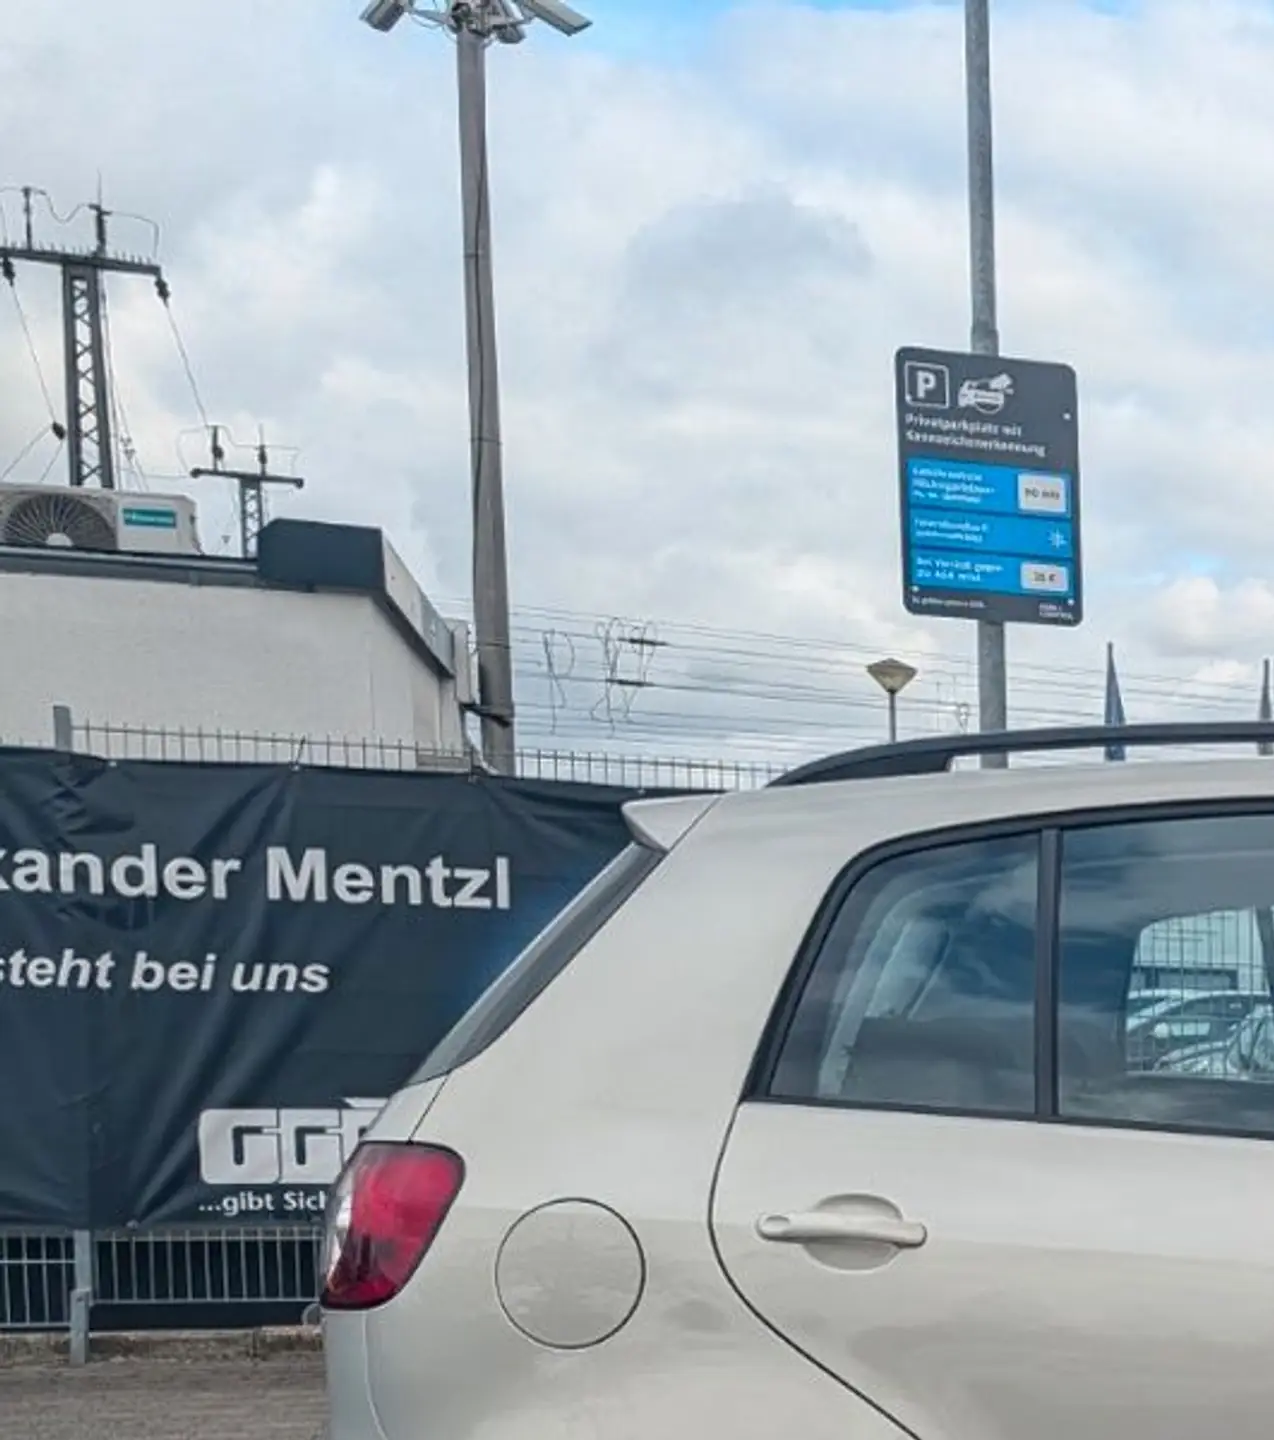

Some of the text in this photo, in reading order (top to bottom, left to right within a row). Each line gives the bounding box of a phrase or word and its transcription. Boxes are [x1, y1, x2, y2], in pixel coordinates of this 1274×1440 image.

[915, 370, 937, 399] P
[0, 844, 511, 909] ander Mentzl
[0, 948, 330, 993] teht bei uns
